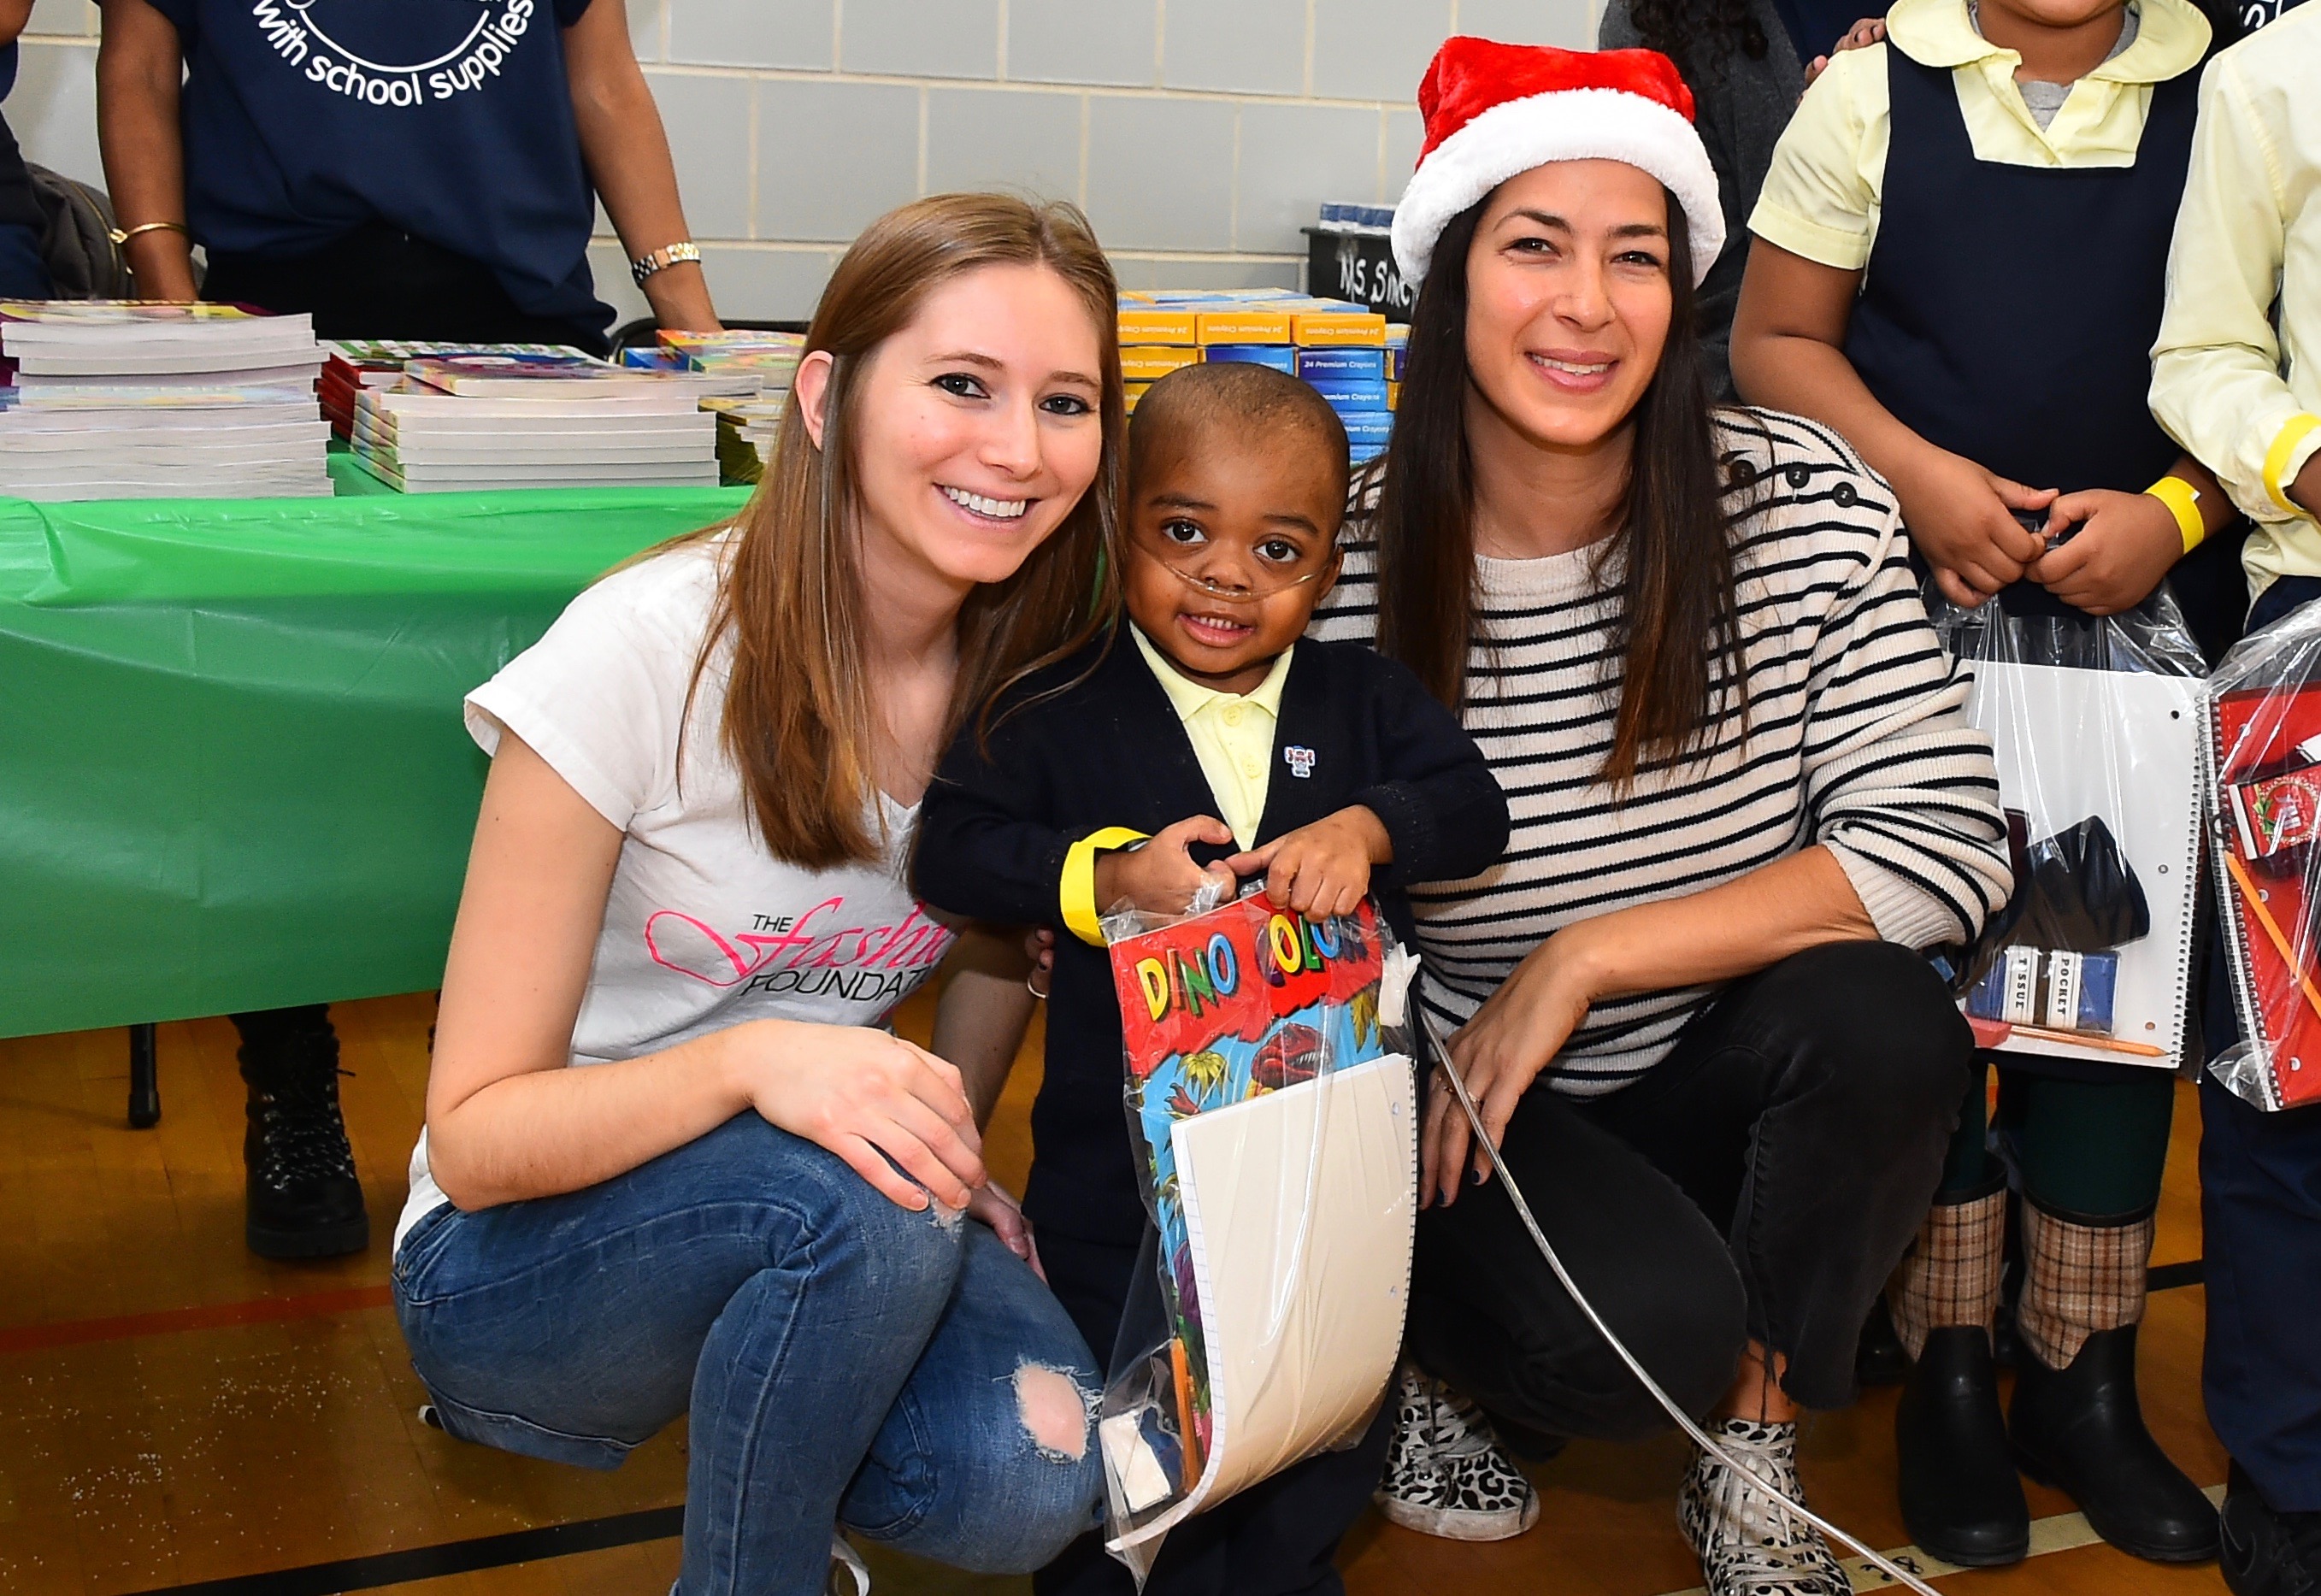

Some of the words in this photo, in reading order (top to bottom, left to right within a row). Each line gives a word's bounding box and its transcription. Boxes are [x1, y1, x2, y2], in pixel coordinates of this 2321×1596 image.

[252, 0, 308, 67] with
[305, 56, 423, 107] school
[429, 0, 534, 99] supplies
[1349, 361, 1377, 370] Crayons
[1351, 393, 1380, 402] Crayons
[752, 914, 794, 933] THE
[739, 966, 932, 1002] FOUNDAT
[1135, 932, 1238, 1022] DINO
[2015, 957, 2028, 1010] TSSUE
[2057, 957, 2071, 1015] POCKET
